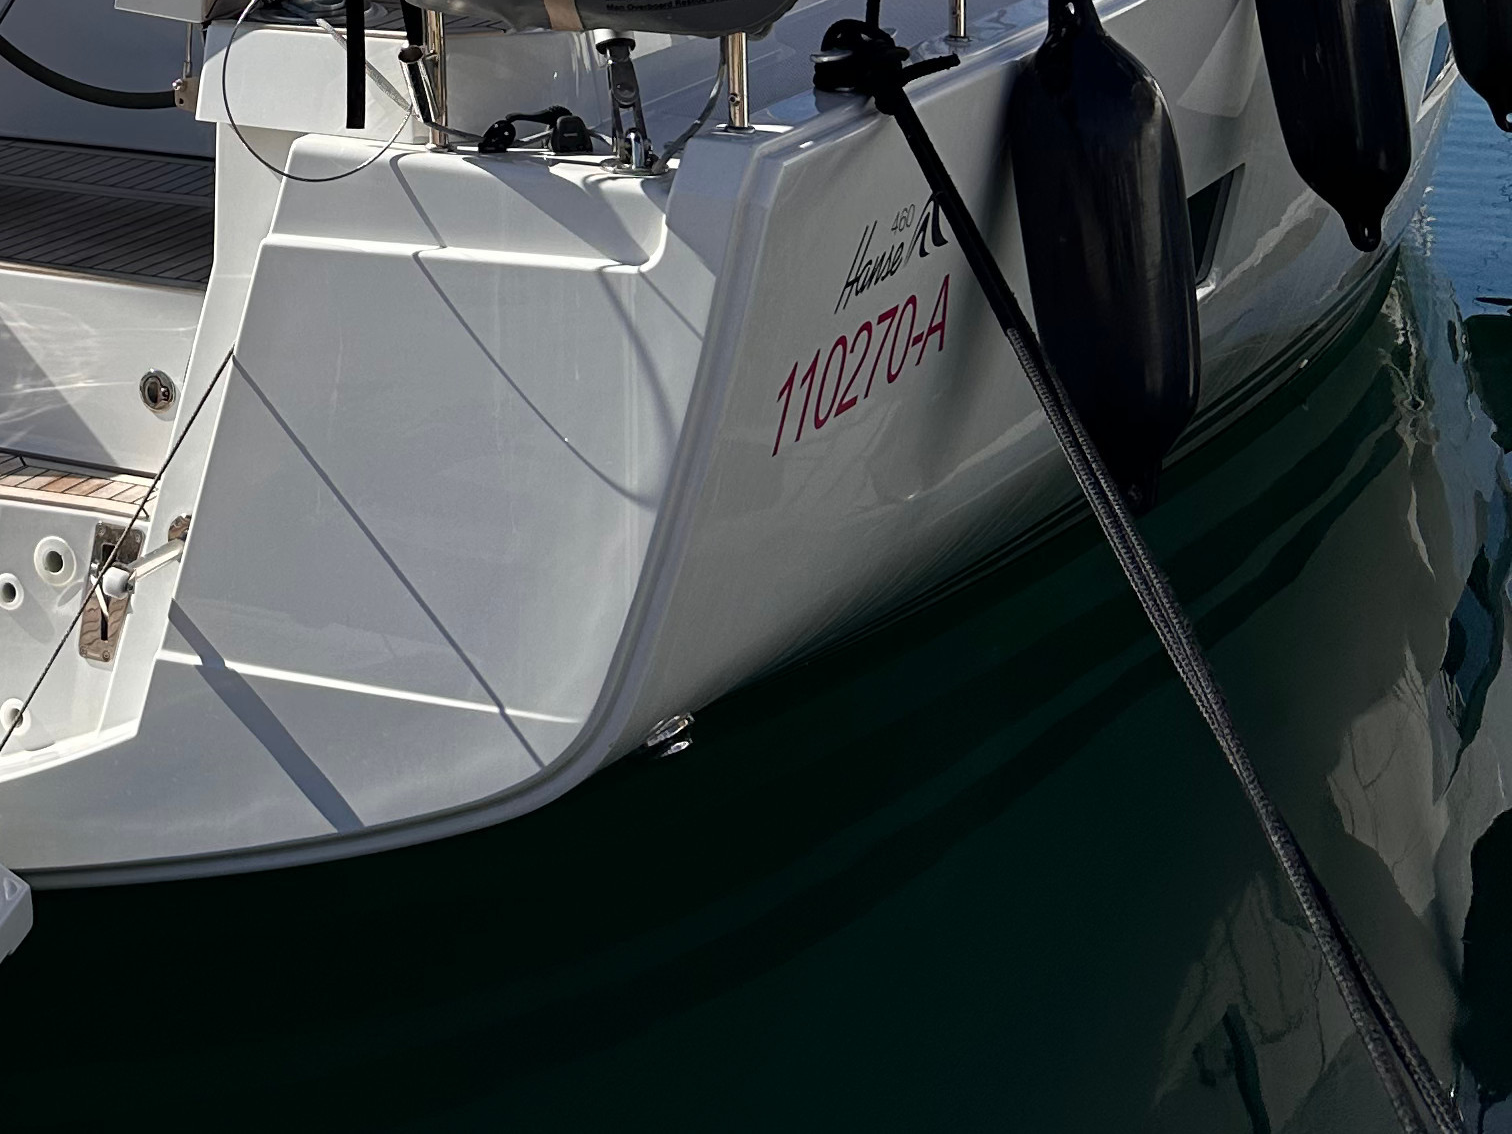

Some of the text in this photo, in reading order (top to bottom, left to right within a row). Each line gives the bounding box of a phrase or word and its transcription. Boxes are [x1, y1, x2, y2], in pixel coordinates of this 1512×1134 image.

[890, 204, 916, 233] 460
[834, 220, 905, 314] Hanse
[772, 273, 951, 458] 110270-A
